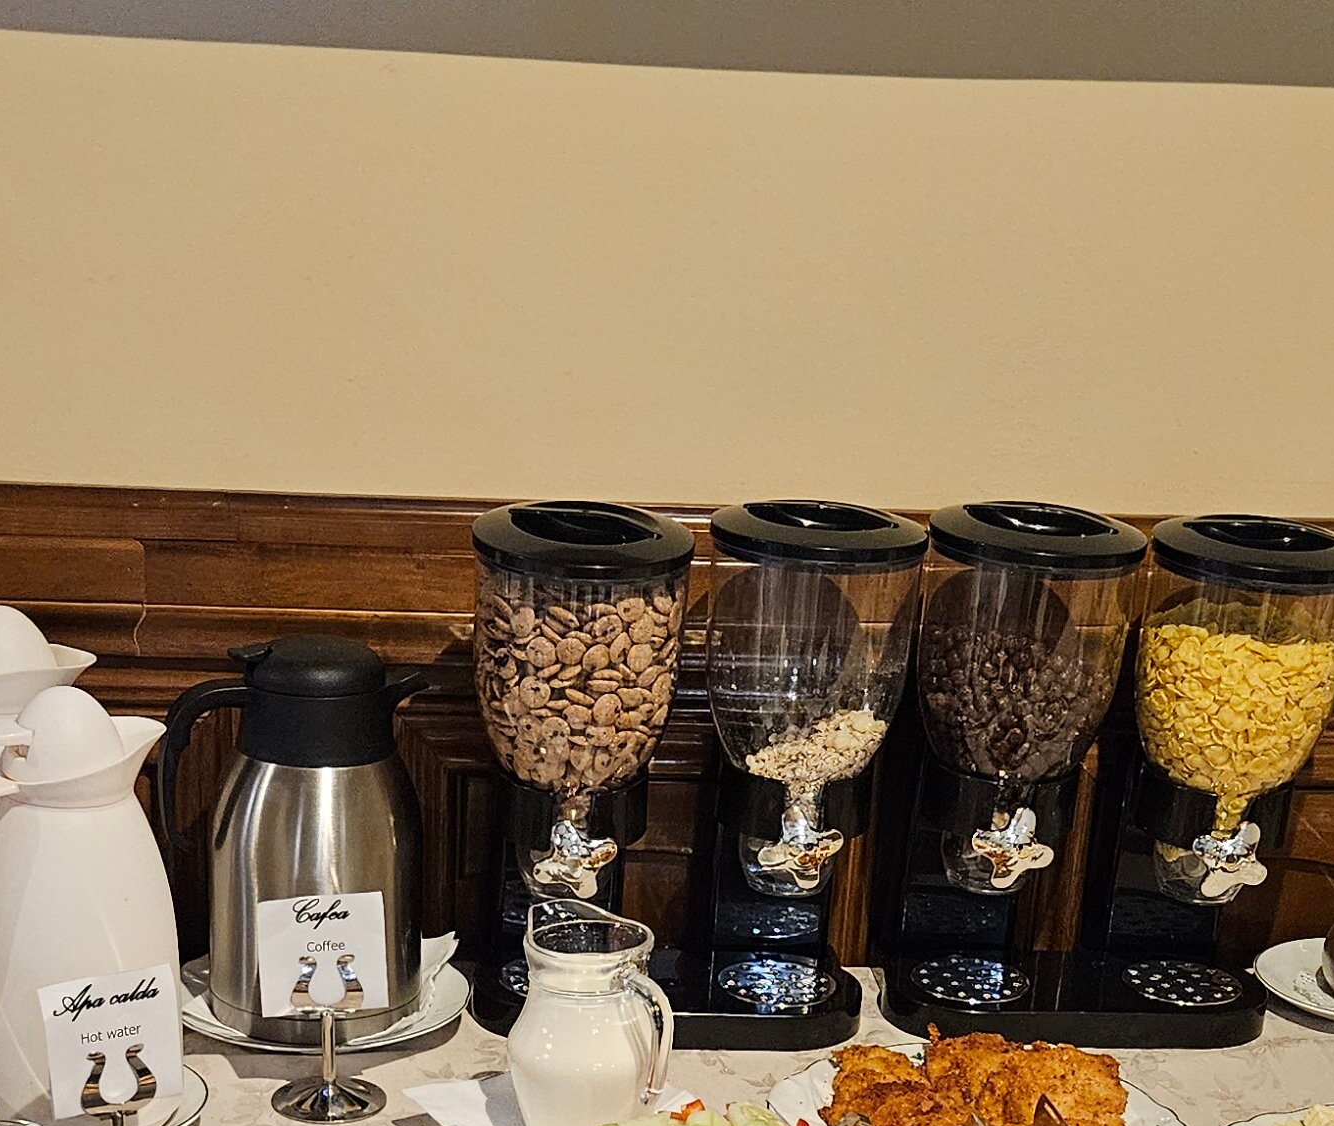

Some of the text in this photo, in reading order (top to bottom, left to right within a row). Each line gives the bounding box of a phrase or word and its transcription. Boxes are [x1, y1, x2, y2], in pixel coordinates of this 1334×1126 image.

[292, 898, 351, 930] Cafea
[306, 940, 346, 953] Coffee
[52, 976, 160, 1022] Apa calda
[80, 1024, 142, 1045] Hot water
